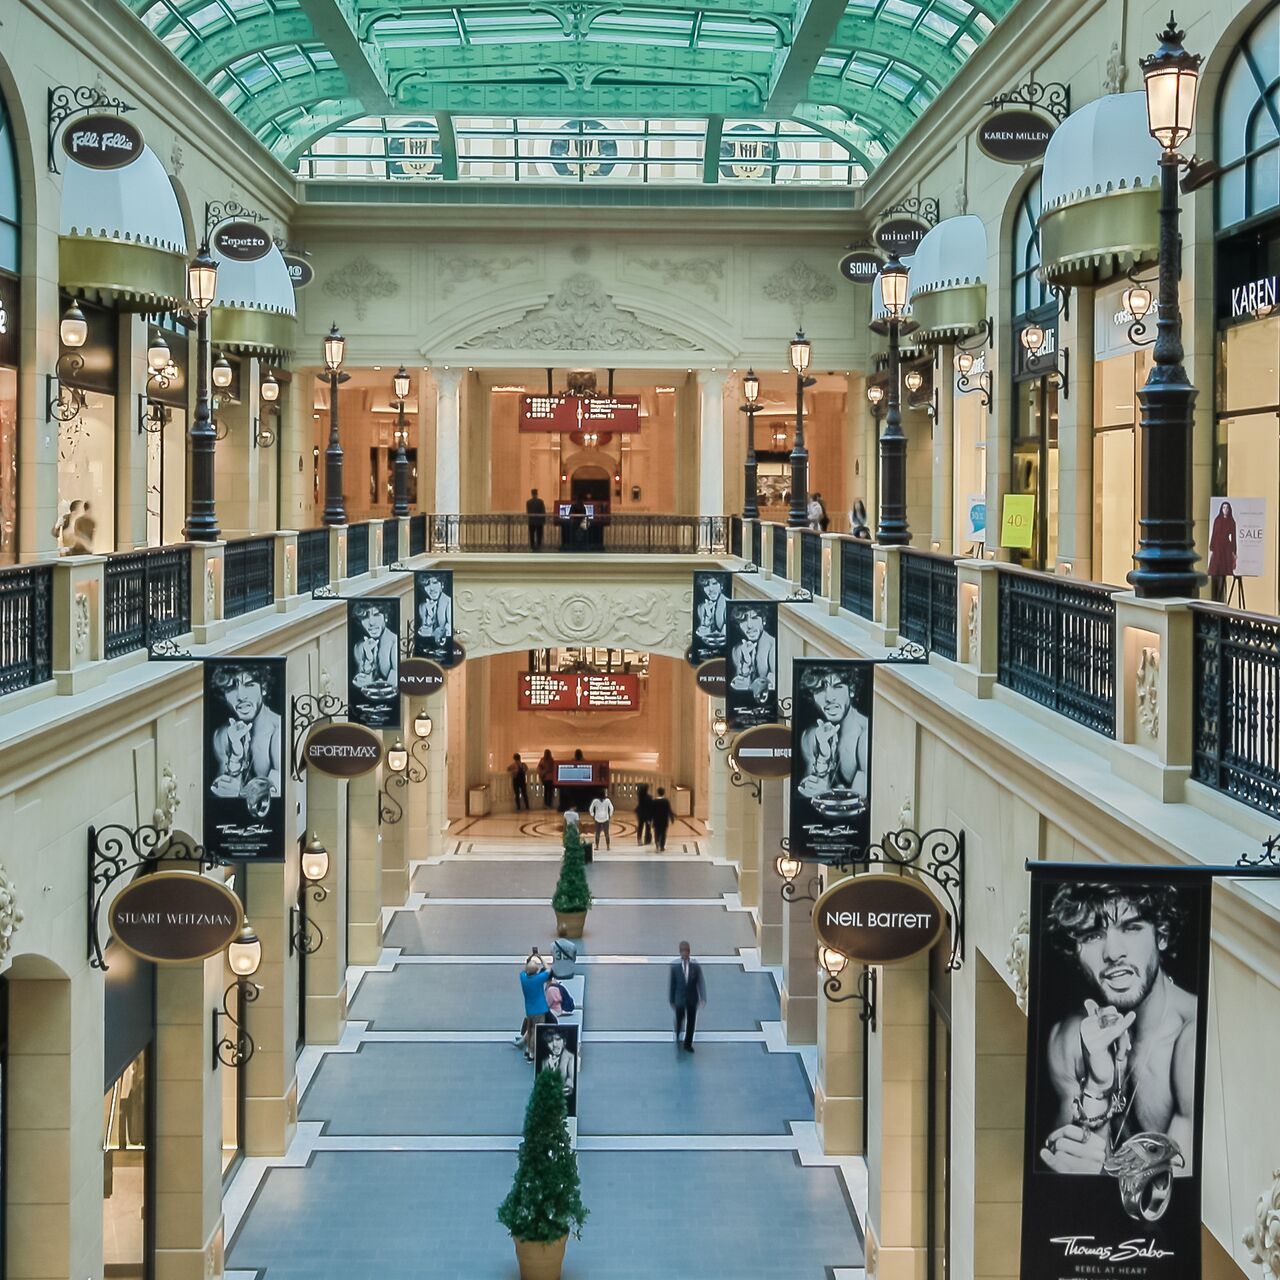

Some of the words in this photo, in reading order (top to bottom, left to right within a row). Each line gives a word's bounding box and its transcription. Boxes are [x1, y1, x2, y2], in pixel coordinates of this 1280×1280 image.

[72, 131, 100, 152] Folli
[101, 132, 133, 151] Follie
[984, 132, 1014, 140] KAREN
[1015, 132, 1050, 140] MILLEN
[850, 262, 877, 274] SONIA
[1231, 276, 1276, 317] KAREN
[1239, 529, 1263, 539] SALE
[309, 745, 376, 757] SPORTMAX
[117, 913, 161, 924] STUART
[166, 913, 233, 925] WEITZMAN
[1050, 1236, 1113, 1260] Thomas
[1109, 1239, 1174, 1261] Sabo
[1075, 1265, 1100, 1273] REBEL
[1119, 1267, 1147, 1275] HEART
